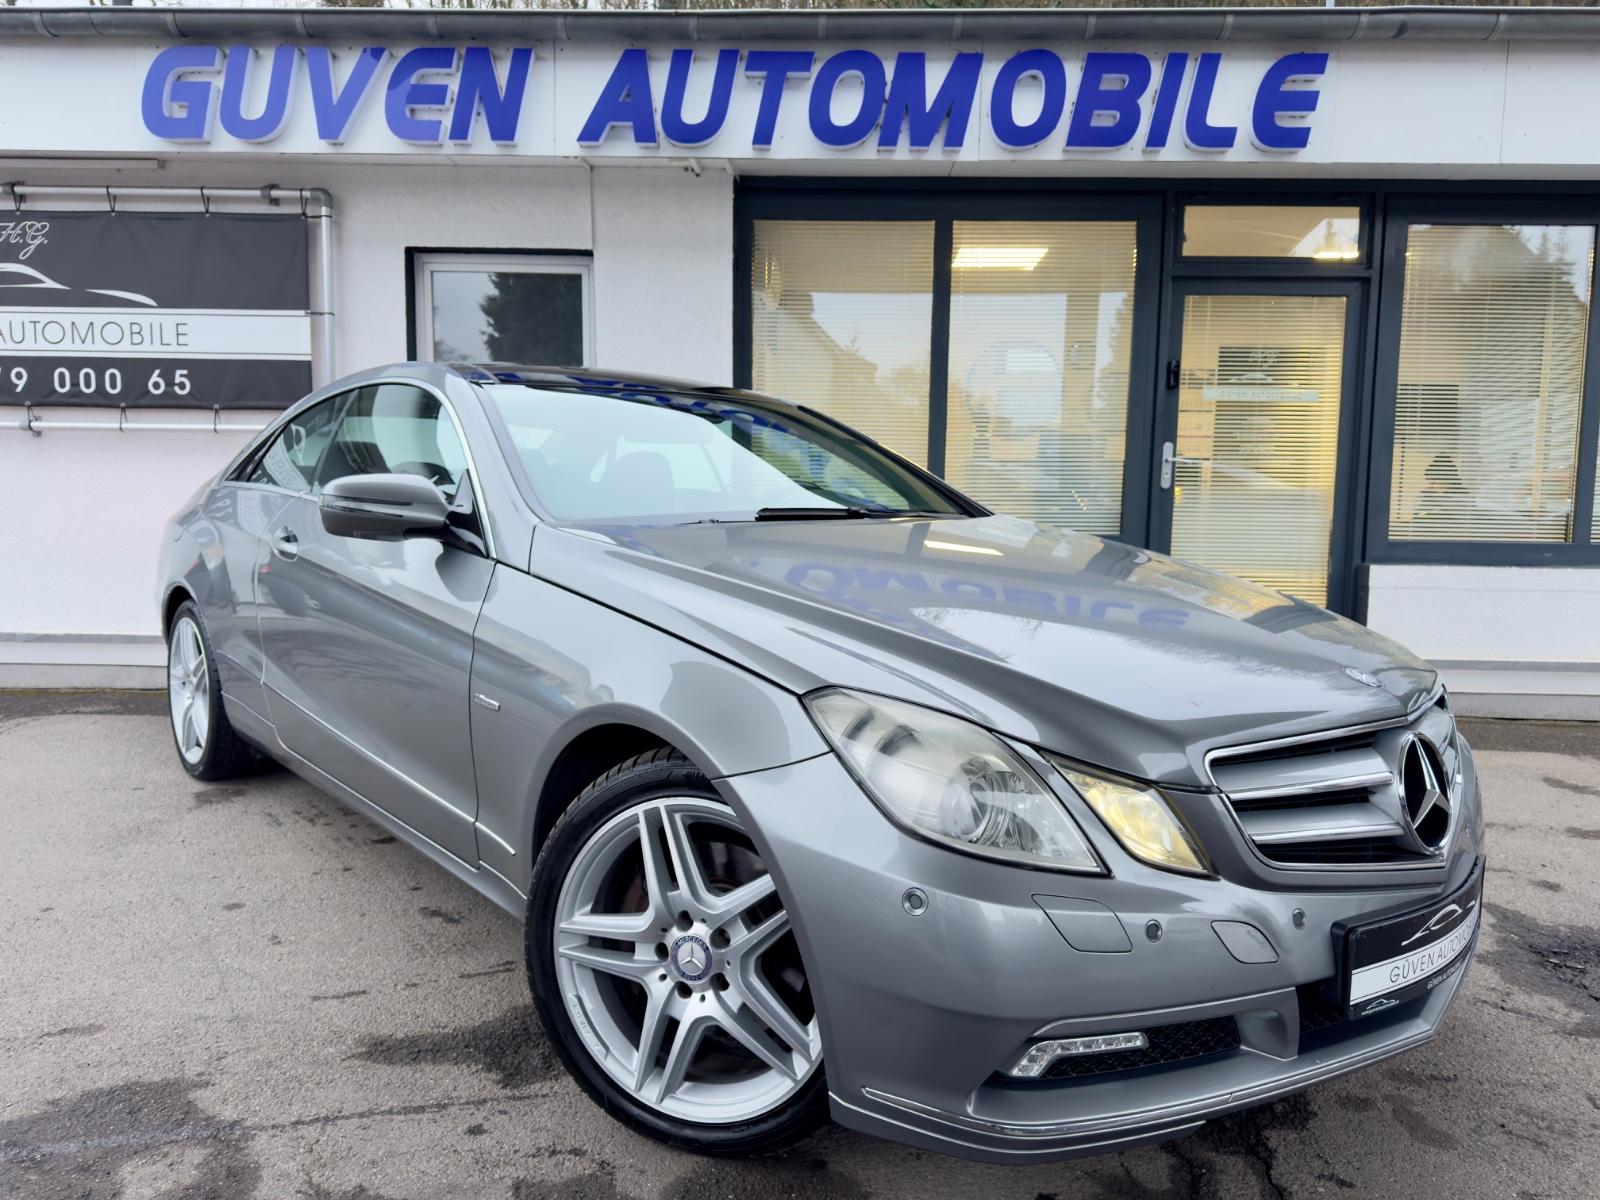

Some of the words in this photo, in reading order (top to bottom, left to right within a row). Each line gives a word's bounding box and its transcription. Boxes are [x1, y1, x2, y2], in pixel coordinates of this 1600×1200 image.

[577, 48, 1330, 152] AUTOMOBILE
[54, 366, 122, 395] 000
[148, 368, 191, 395] 65
[1390, 950, 1434, 984] GÜVEN
